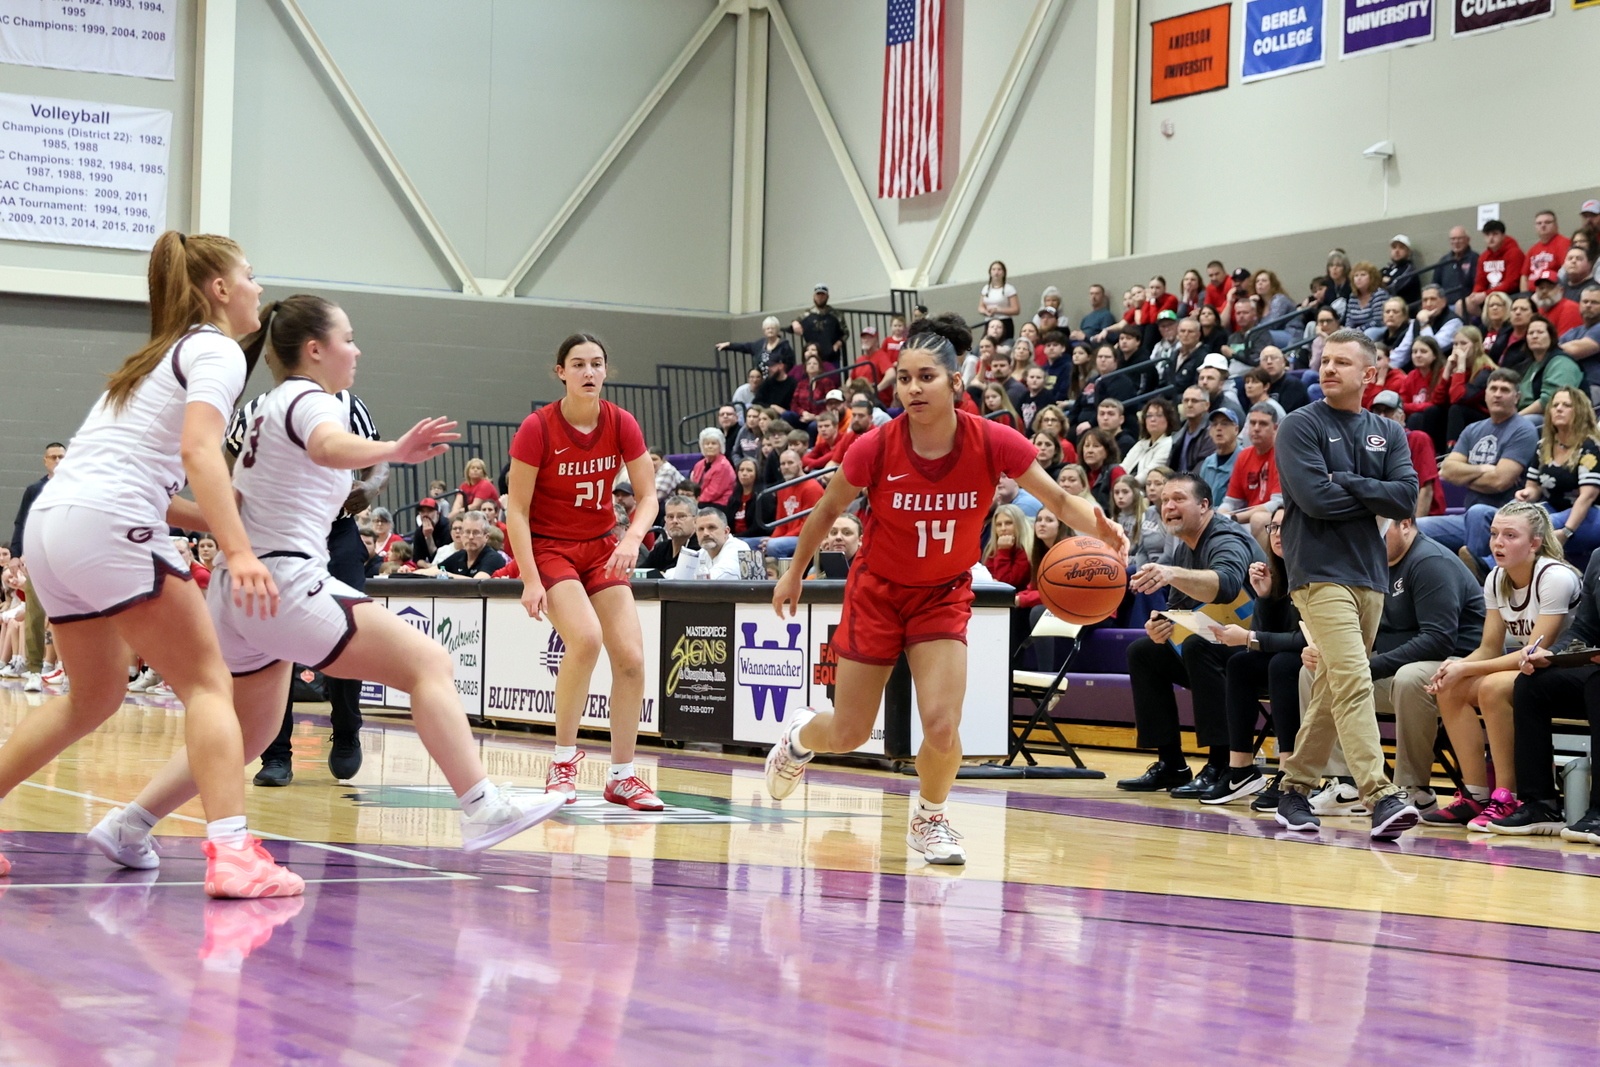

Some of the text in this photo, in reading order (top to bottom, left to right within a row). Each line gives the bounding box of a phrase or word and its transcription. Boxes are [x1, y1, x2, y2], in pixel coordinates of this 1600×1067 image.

[62, 6, 86, 17] 1995
[139, 1, 165, 13] 1994,
[1346, 0, 1429, 34] UNIVERSITY
[13, 16, 78, 33] Champions:
[82, 24, 108, 36] 1999,
[112, 27, 139, 40] 2004,
[142, 30, 166, 42] 2008
[1261, 6, 1307, 33] BEREA
[1168, 28, 1211, 50] ANDERSON
[1252, 26, 1314, 57] COLLEGE
[1164, 56, 1213, 80] UNIVERSITY
[30, 103, 110, 125] Volleyball
[2, 121, 166, 147] Champions (District 22): 1982,
[42, 138, 98, 153] 1985, 1988
[8, 150, 74, 165] Champions:
[78, 157, 106, 170] 1982,
[109, 160, 136, 173] 1984,
[140, 163, 166, 176] 1985,
[26, 166, 113, 183] 1987, 1988, 1990
[23, 181, 88, 196] Champions:
[94, 187, 122, 201] 2009,
[125, 190, 148, 202] 2011
[19, 197, 87, 213] Tournament:
[94, 203, 121, 217] 1994,
[125, 206, 151, 219] 1996,
[8, 212, 36, 225] 2009,
[40, 214, 68, 228] 2013,
[71, 217, 99, 230] 2014,
[102, 220, 129, 233] 2015,
[132, 223, 156, 235] 2016
[557, 454, 617, 476] BELLEVUE
[892, 490, 978, 511] BELLEVUE
[914, 519, 957, 558] 14
[1064, 562, 1119, 582] Rawlings
[685, 626, 727, 638] MASTERPIECE
[460, 653, 477, 667] PIZZA
[666, 634, 727, 697] SIGNS
[739, 657, 802, 677] Wannemacher
